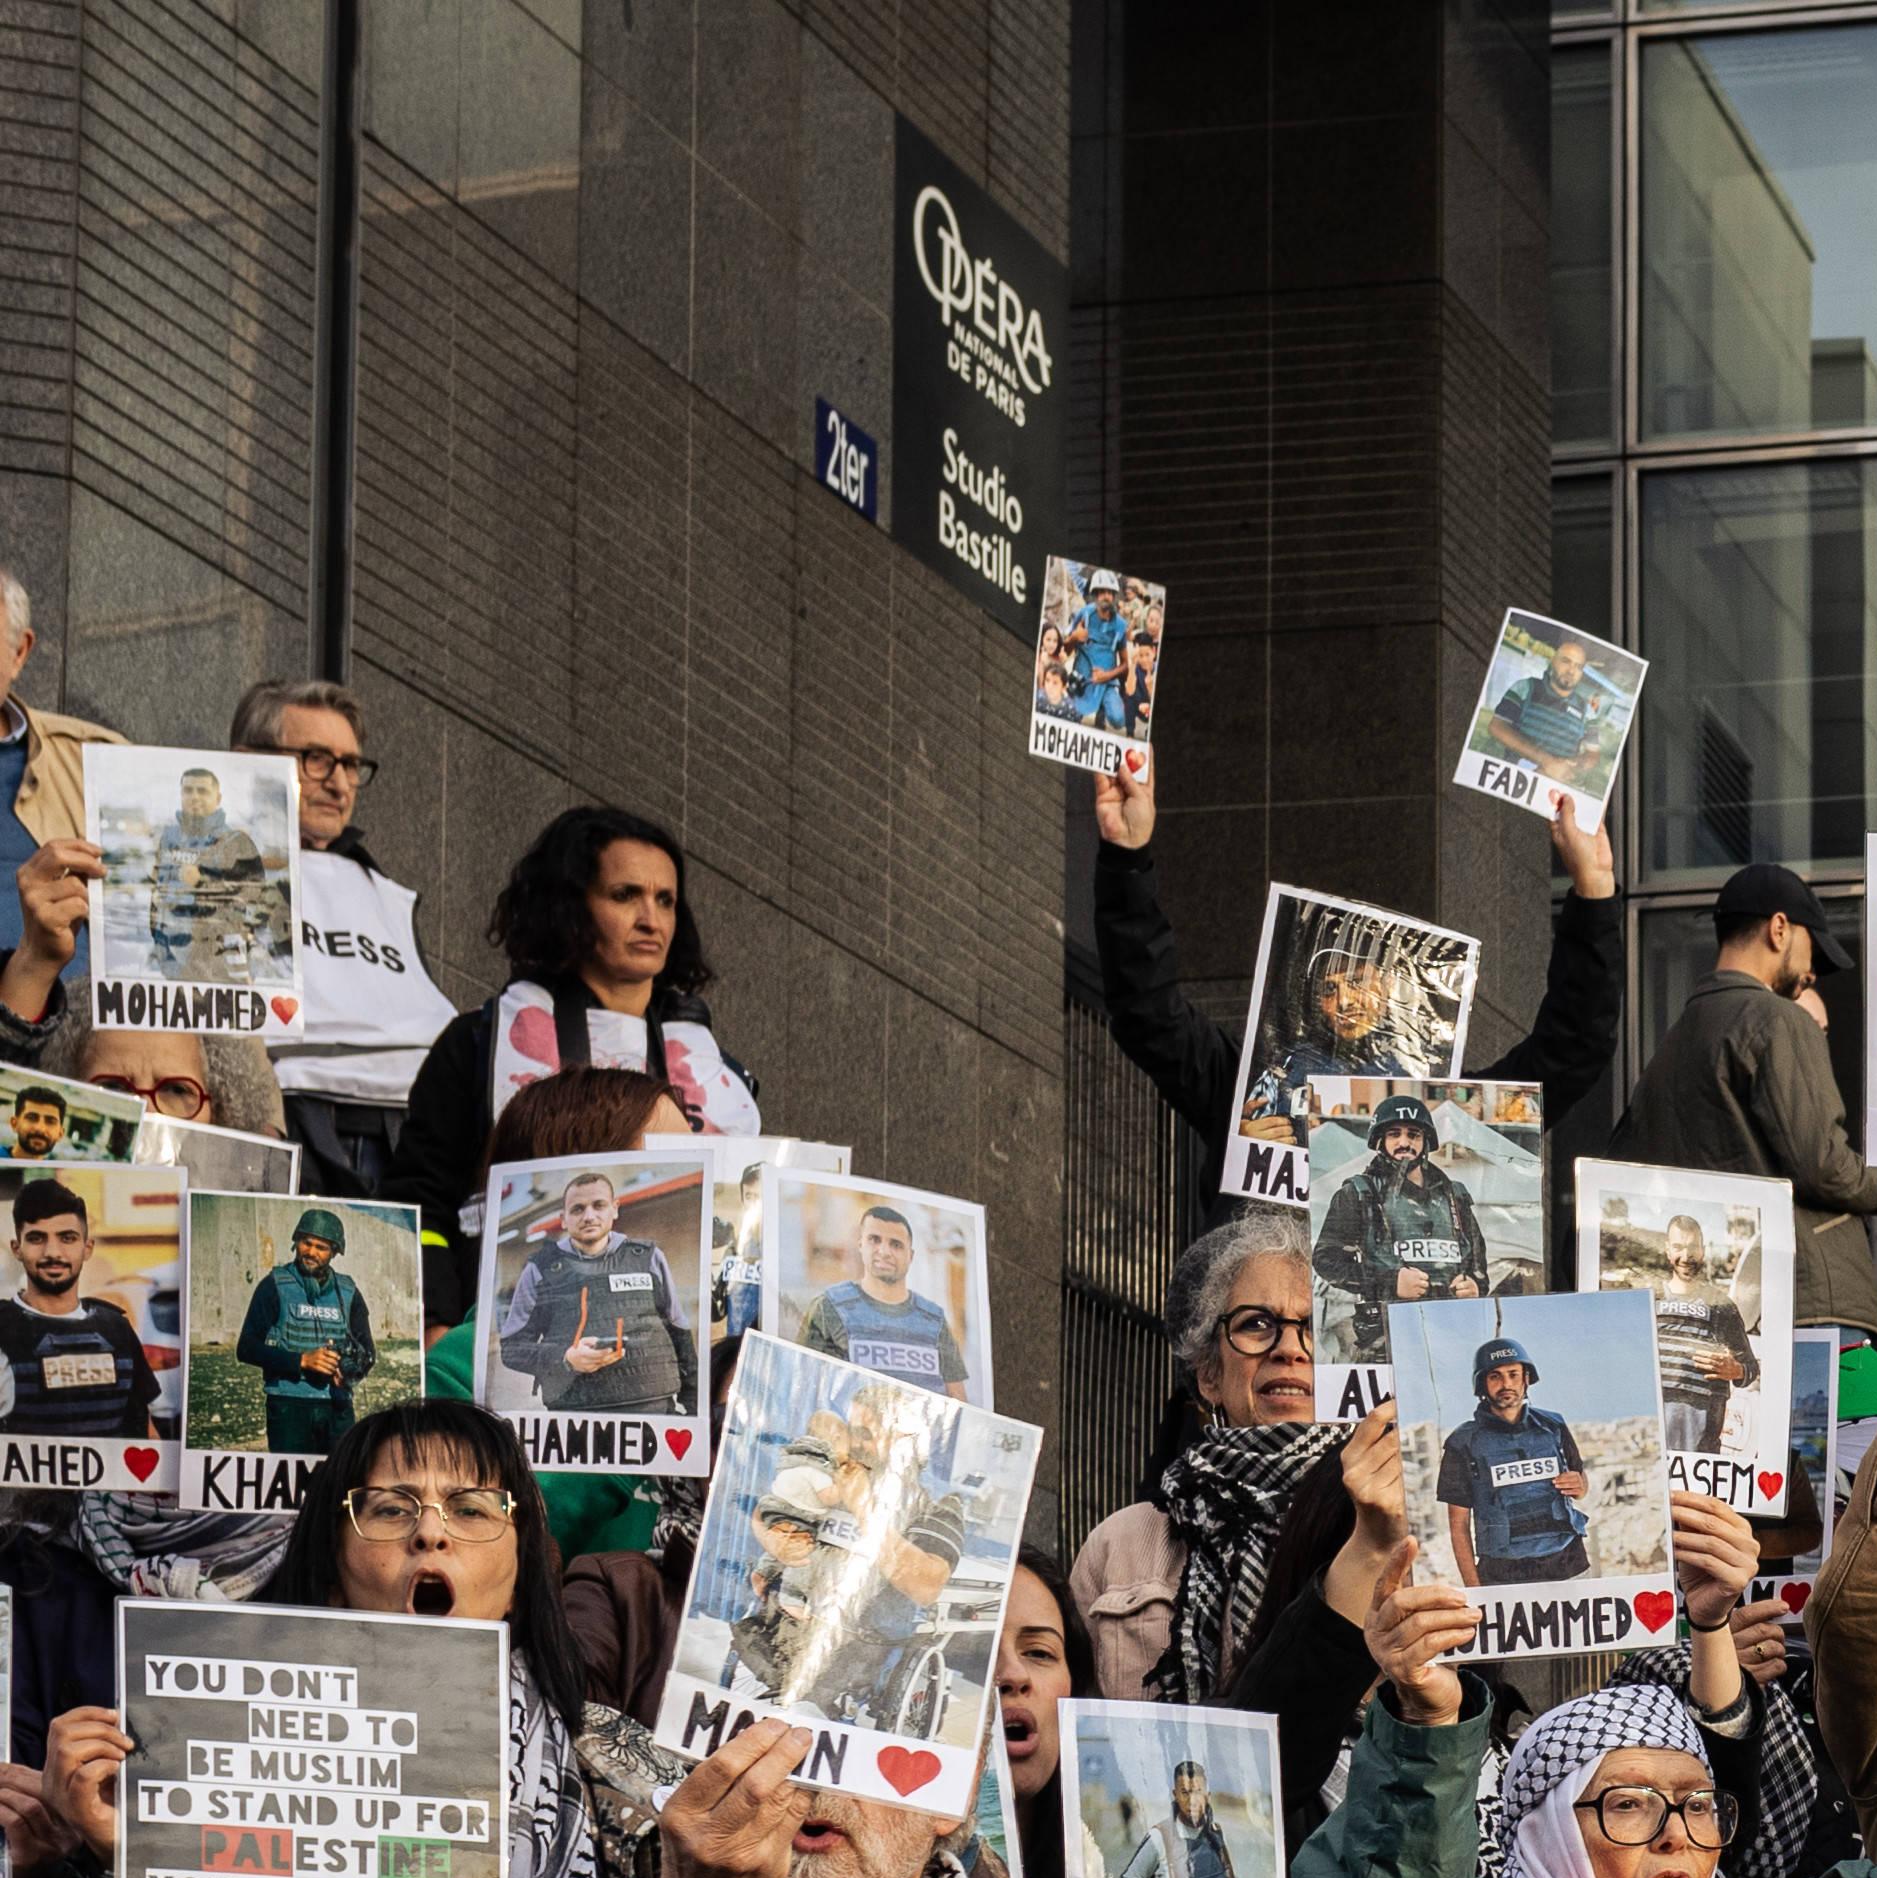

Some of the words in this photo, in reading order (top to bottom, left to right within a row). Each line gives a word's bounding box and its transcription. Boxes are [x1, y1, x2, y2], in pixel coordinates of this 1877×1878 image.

[955, 320, 1019, 390] NATIONAL
[947, 342, 974, 384] DE
[976, 370, 1026, 427] PARIS
[826, 409, 868, 510] 2ter
[943, 428, 1022, 532] Studio
[939, 491, 1027, 603] Bastille
[1034, 718, 1122, 774] MOHAMMED
[1477, 758, 1538, 806] FADI
[97, 980, 267, 1032] MOHAMMED
[1396, 1108, 1419, 1120] TV
[1400, 1240, 1460, 1261] PRESS
[612, 1273, 652, 1290] PRESS
[299, 1303, 339, 1320] PRESS
[1659, 1302, 1706, 1318] PRESS
[852, 1345, 937, 1372] PRESS
[1490, 1348, 1517, 1360] PRESS
[46, 1363, 116, 1386] PRESS
[1495, 1460, 1554, 1483] PRESS
[1439, 1596, 1633, 1657] OHAMMED
[148, 1661, 226, 1694] YOU
[243, 1667, 355, 1701] DON'T
[251, 1709, 350, 1742] NEED
[366, 1716, 415, 1747] TO
[191, 1747, 234, 1778] BE
[250, 1750, 398, 1788] MUSLIM
[141, 1786, 193, 1816] TO
[208, 1791, 339, 1828] STAND
[355, 1799, 401, 1831] UP
[417, 1804, 486, 1836] FOR
